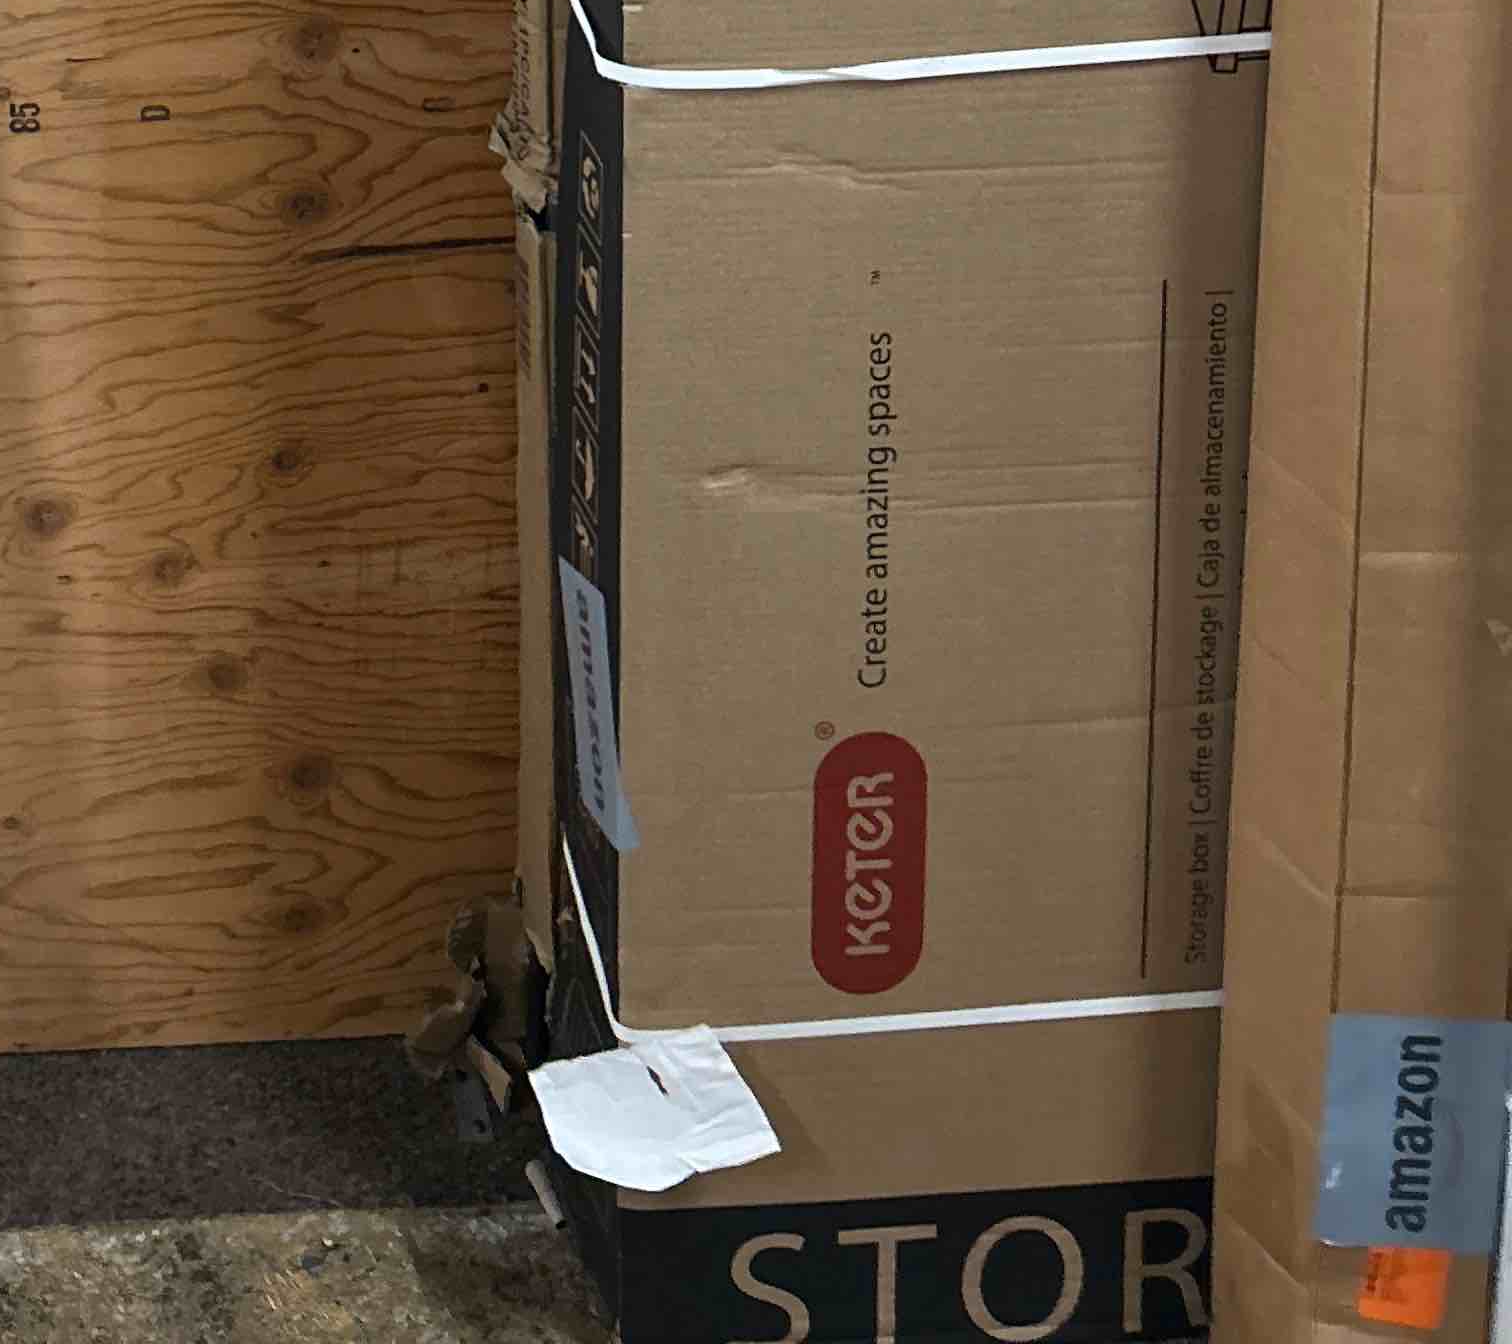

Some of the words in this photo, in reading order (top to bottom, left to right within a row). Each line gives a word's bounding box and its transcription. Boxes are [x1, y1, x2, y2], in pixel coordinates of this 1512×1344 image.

[9, 102, 41, 133] 85
[870, 330, 898, 437] spaces
[1199, 302, 1228, 497] almacenamiento
[859, 445, 898, 579] amazing
[1199, 502, 1221, 532] de
[1196, 538, 1225, 589] Caja
[857, 589, 888, 689] Create
[1194, 605, 1225, 704] stockage
[1190, 713, 1214, 741] de
[1191, 751, 1214, 814] Coffre
[844, 771, 894, 956] KETER
[1187, 832, 1210, 873] box
[1184, 879, 1215, 965] Storage
[1385, 1033, 1444, 1234] amazon
